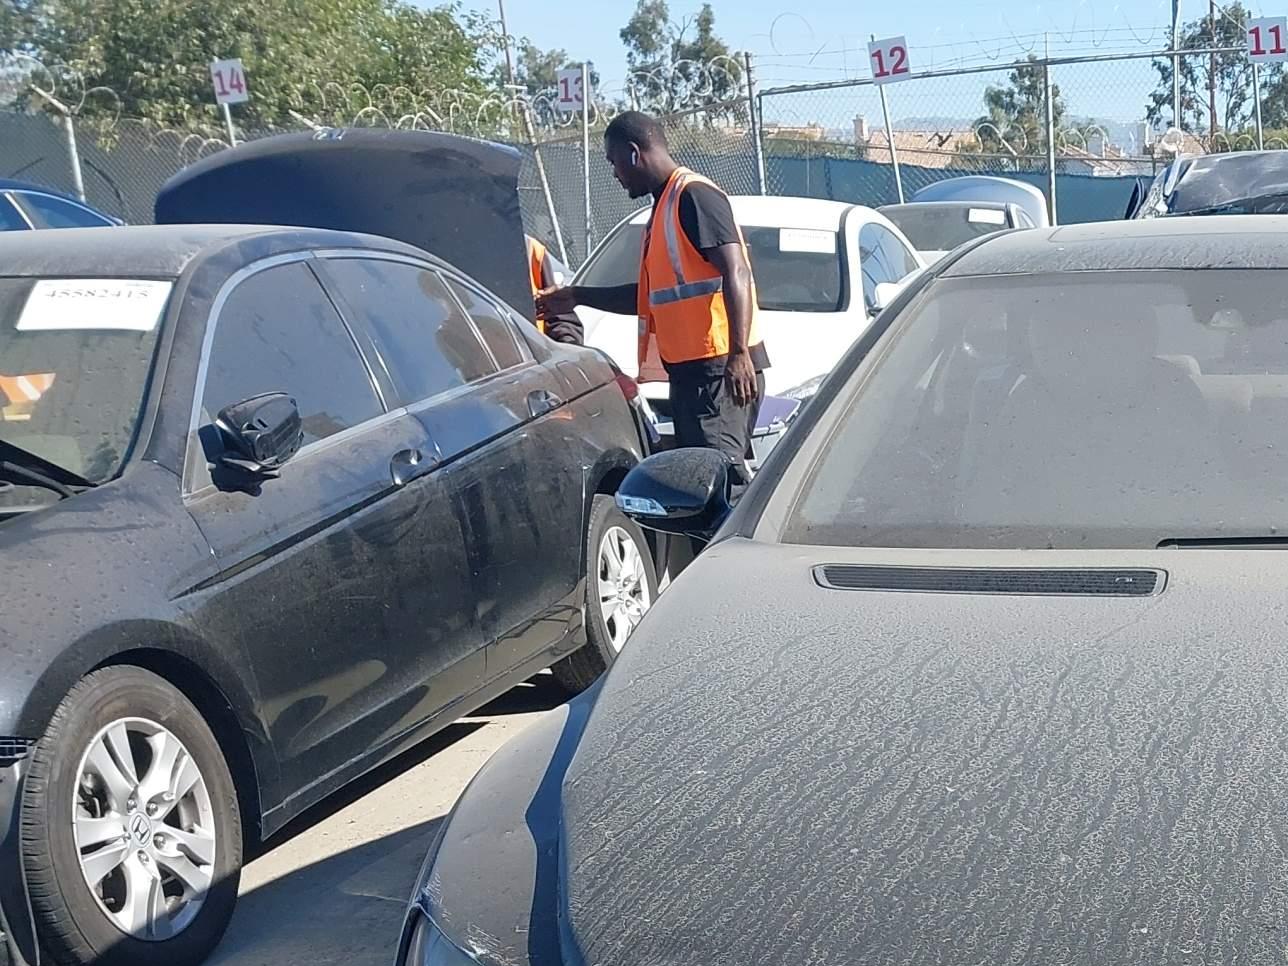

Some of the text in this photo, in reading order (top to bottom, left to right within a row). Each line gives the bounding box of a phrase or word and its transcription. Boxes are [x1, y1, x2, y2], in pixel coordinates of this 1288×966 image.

[1248, 25, 1286, 55] 11
[871, 46, 909, 78] 12
[214, 67, 244, 96] 14
